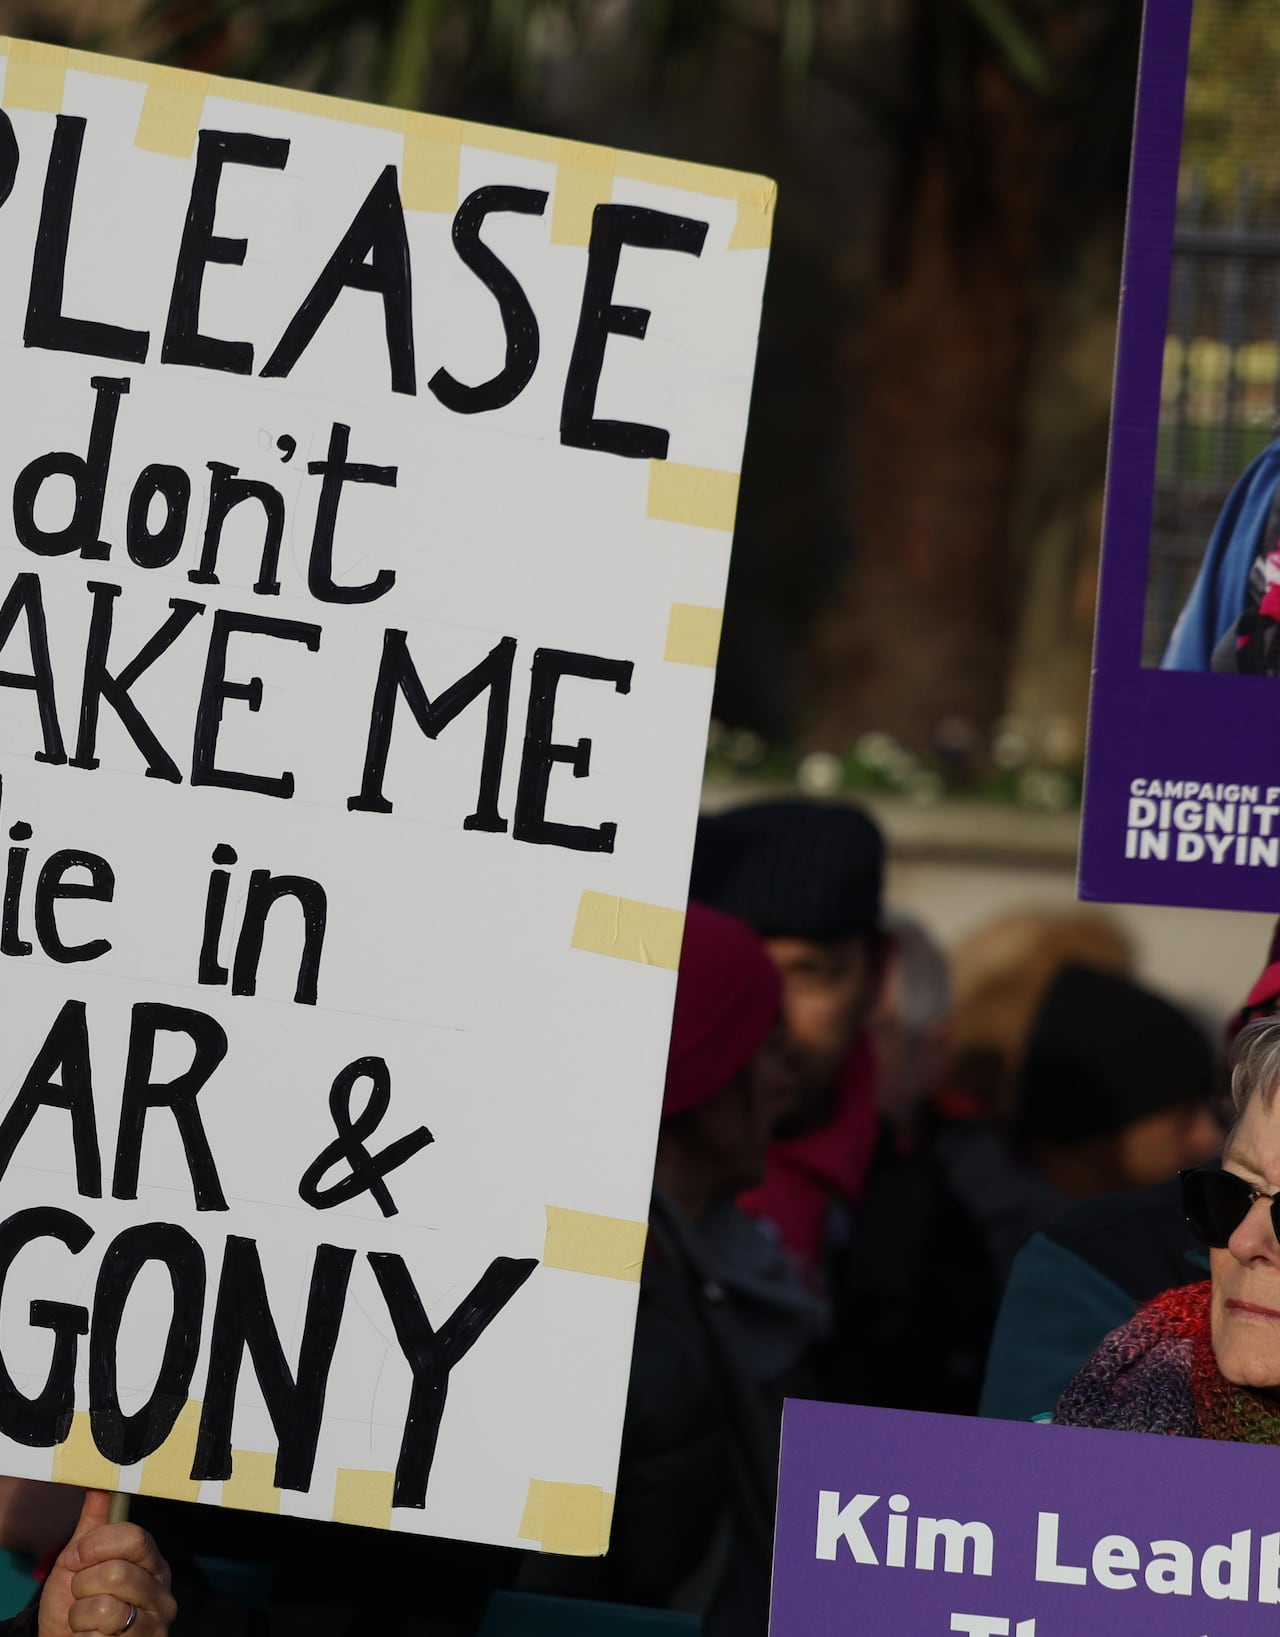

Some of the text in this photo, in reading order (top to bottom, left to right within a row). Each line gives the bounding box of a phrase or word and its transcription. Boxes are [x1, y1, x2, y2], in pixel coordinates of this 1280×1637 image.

[12, 375, 399, 605] don't
[346, 628, 635, 855] ME
[1130, 778, 1258, 804] CAMPAIGN
[197, 843, 328, 1006] in
[1125, 828, 1170, 861] IN
[298, 1055, 435, 1219] &
[815, 1489, 994, 1577] Kim
